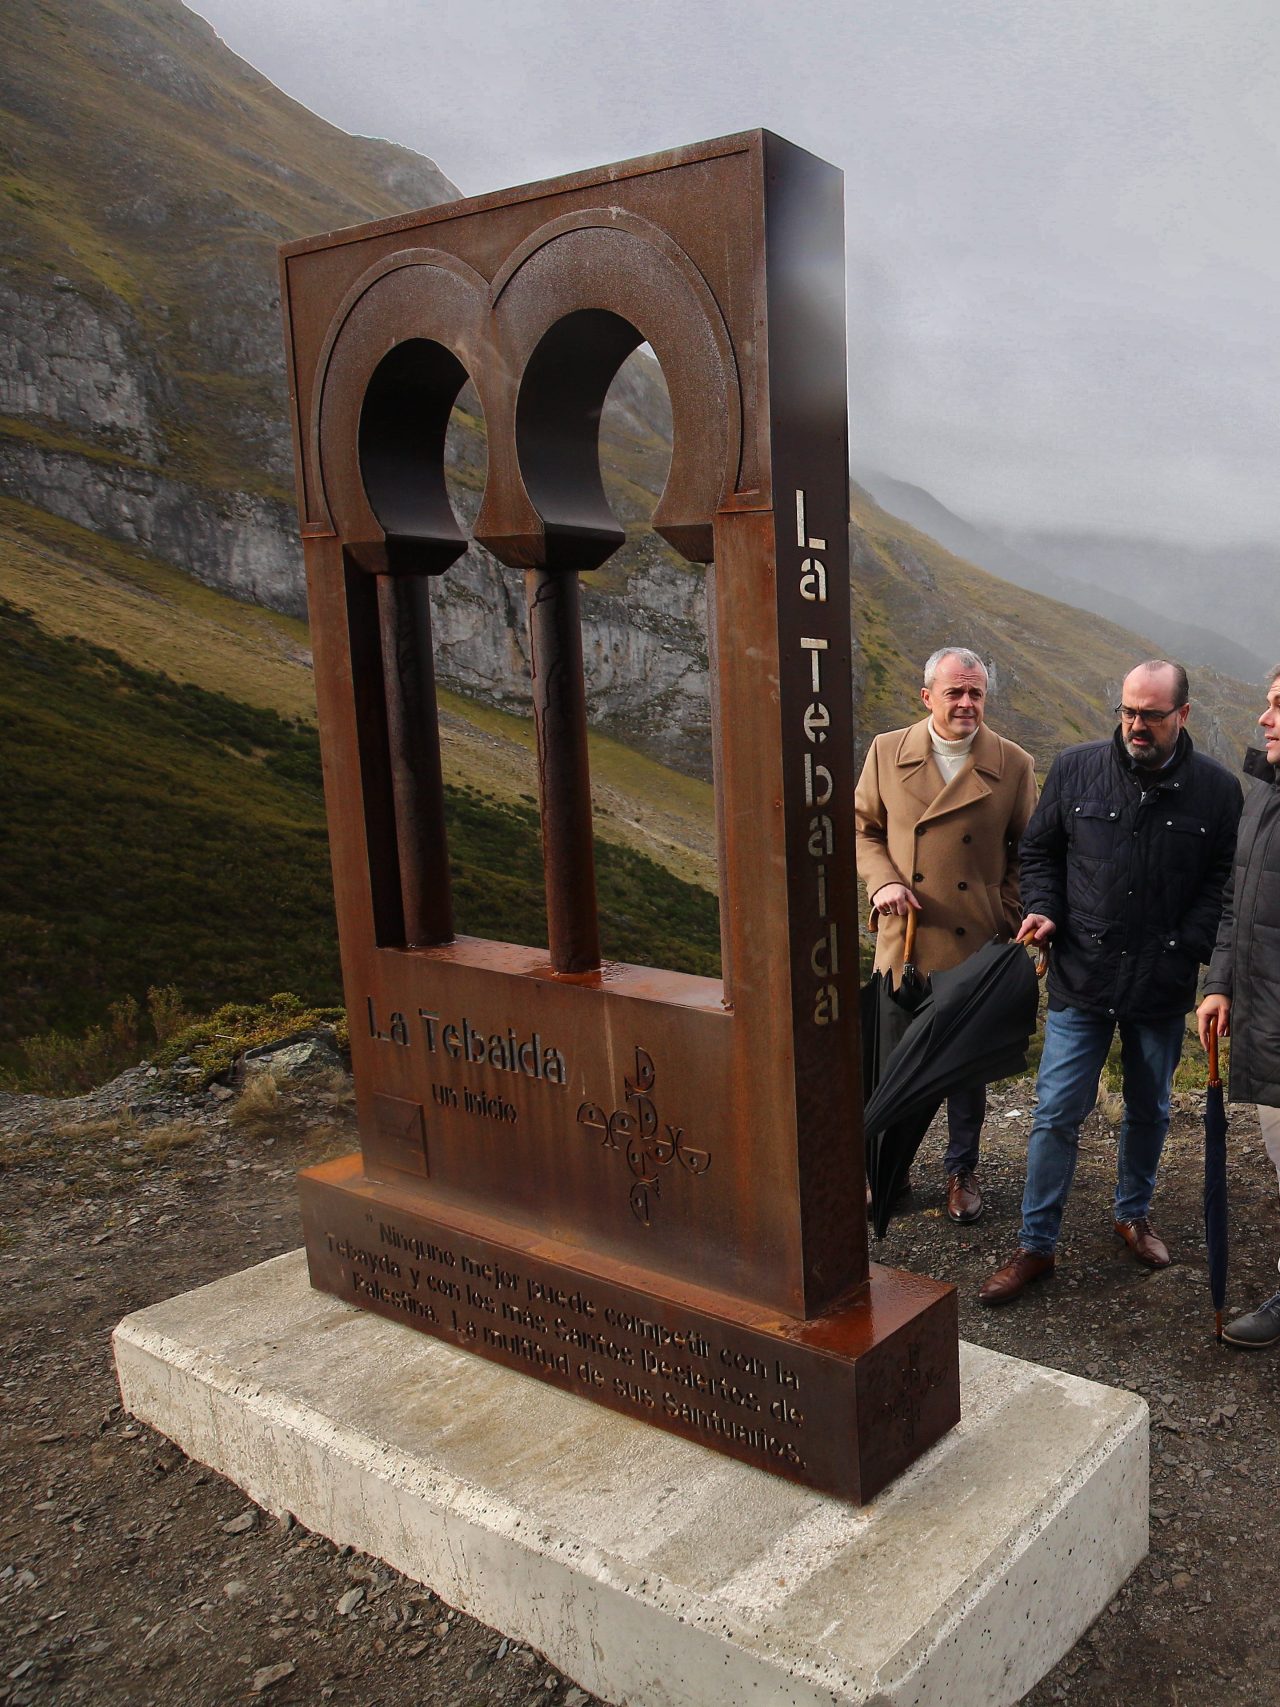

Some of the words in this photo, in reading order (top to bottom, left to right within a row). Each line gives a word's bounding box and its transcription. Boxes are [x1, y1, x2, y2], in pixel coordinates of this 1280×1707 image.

[795, 489, 827, 601] La
[801, 637, 840, 1024] Tebaida
[367, 995, 410, 1047] La
[419, 1008, 566, 1085] Tebaida
[432, 1083, 459, 1108] un
[464, 1086, 517, 1124] inicio
[324, 1231, 401, 1278] Tebayda
[409, 1267, 420, 1290] y
[427, 1273, 461, 1302] con
[466, 1284, 497, 1313] los
[502, 1302, 548, 1334] más
[554, 1318, 635, 1366] Santos
[641, 1349, 761, 1412] Desiertos
[770, 1399, 804, 1428] de
[352, 1272, 440, 1324] Palestina.
[450, 1310, 477, 1338] La
[484, 1327, 571, 1376] multitud
[577, 1361, 605, 1387] de
[613, 1377, 655, 1408] sus
[461, 1255, 520, 1291] mejor
[526, 1279, 597, 1318] puede
[604, 1308, 711, 1359] competir
[719, 1348, 767, 1379] con
[775, 1360, 800, 1391] la
